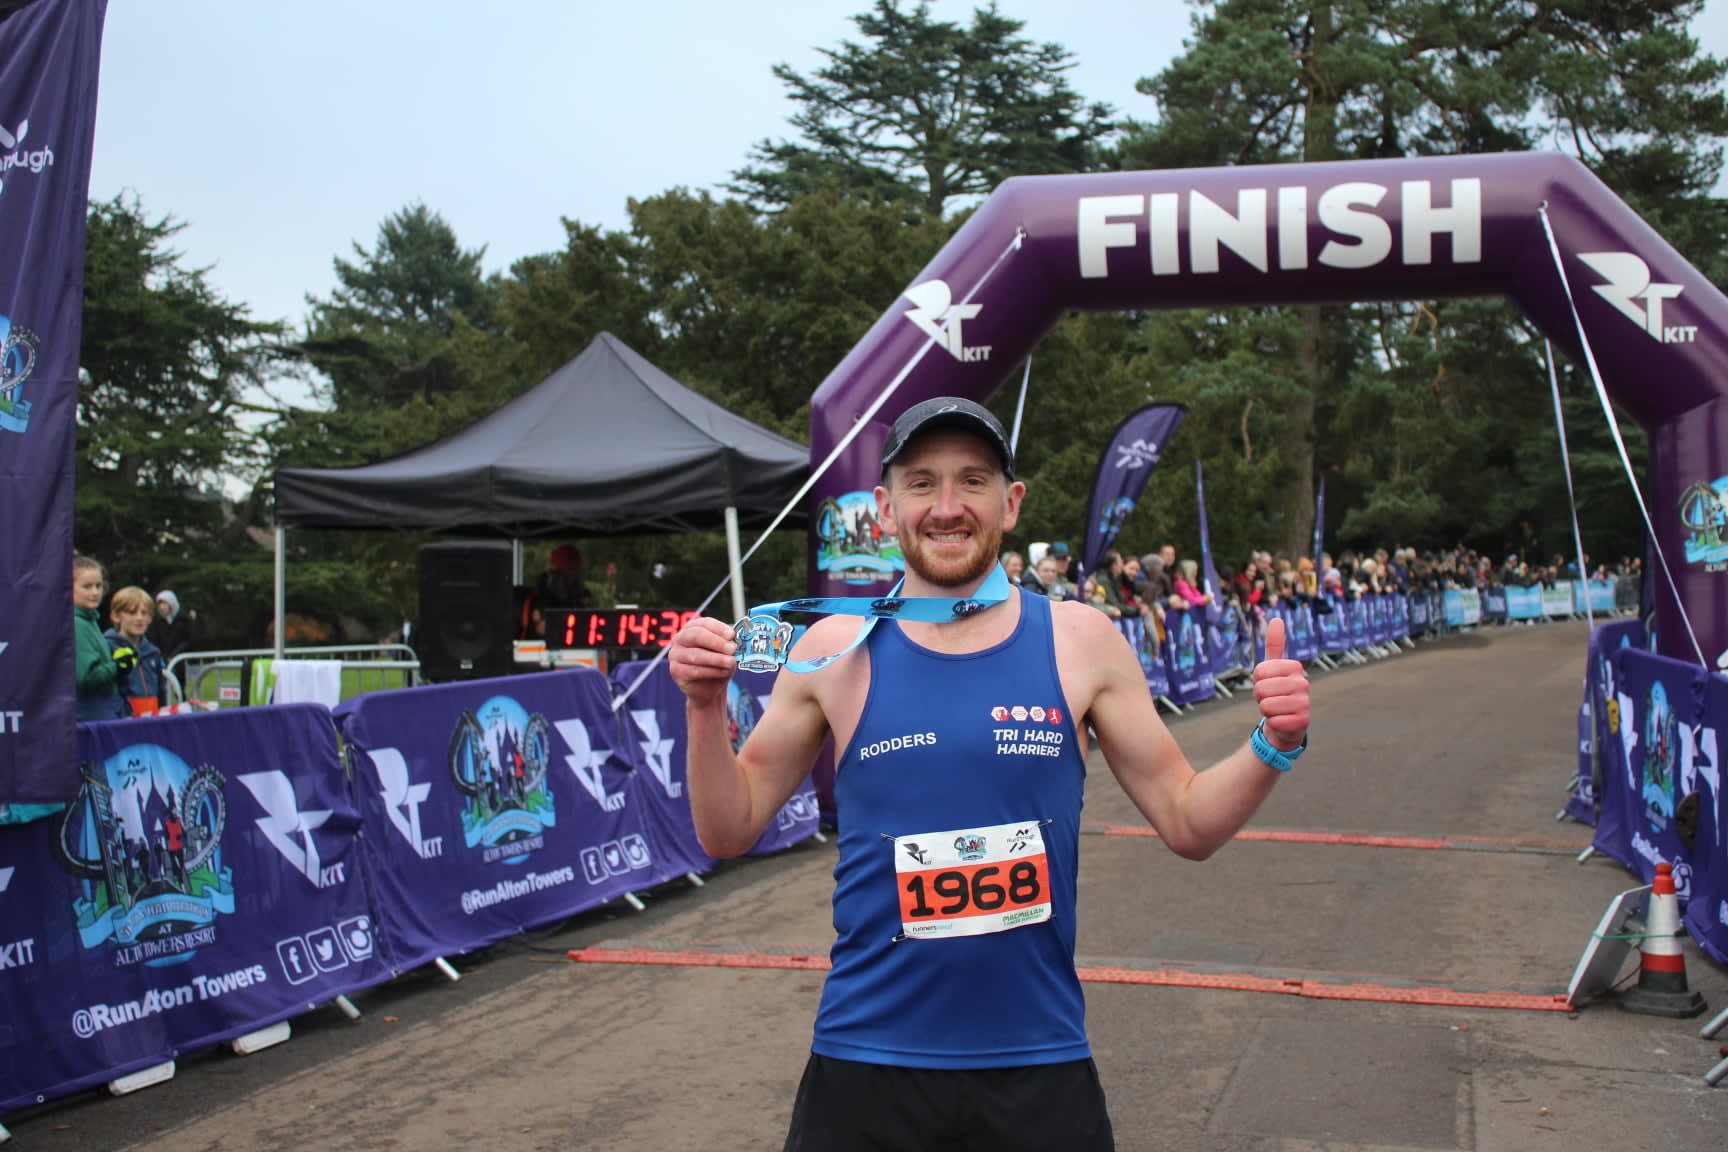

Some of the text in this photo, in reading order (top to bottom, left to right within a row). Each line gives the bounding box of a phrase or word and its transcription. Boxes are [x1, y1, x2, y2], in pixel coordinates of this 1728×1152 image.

[1078, 178, 1482, 279] FINISH
[1664, 326, 1698, 343] KIT
[963, 345, 992, 362] KIT
[565, 611, 701, 647] 11:14:3
[0, 711, 24, 733] IT
[860, 732, 937, 761] RODDERS
[992, 728, 1064, 745] TRI HARD
[996, 743, 1061, 758] HARRIERS
[422, 837, 442, 860] KIT
[320, 862, 344, 888] KIT
[906, 861, 1041, 917] 1968
[158, 922, 172, 935] AT
[0, 938, 34, 970] KIT
